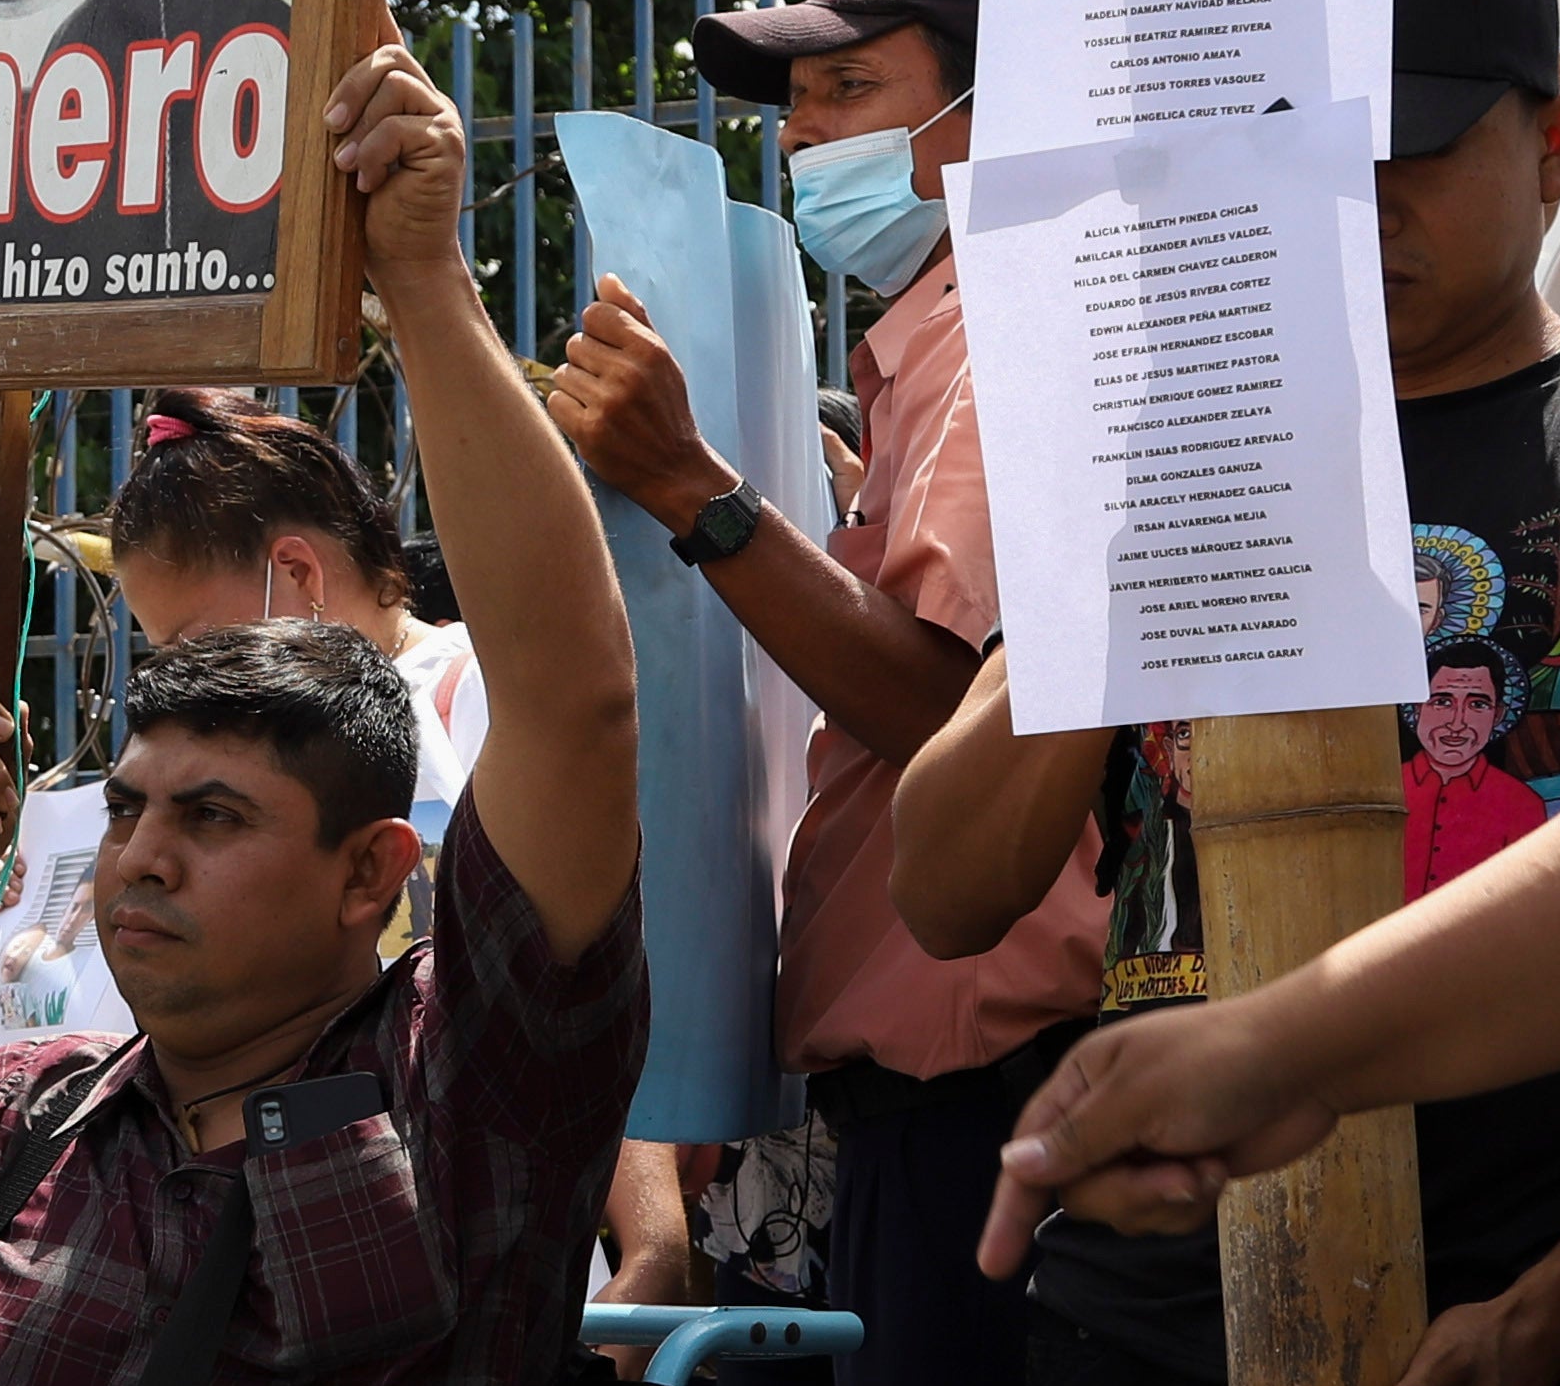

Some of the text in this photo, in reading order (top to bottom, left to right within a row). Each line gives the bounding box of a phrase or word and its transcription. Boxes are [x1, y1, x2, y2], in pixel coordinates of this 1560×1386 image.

[1110, 49, 1241, 69] CARLOS ANTONIO AMAYA
[1097, 104, 1255, 126] EVELIN ANGELICA CRUZ TEVEZ
[1084, 204, 1258, 239] ALICIA YAMILETH PINEDA CHICAS
[2, 242, 89, 298] hizo
[105, 240, 277, 295] santo...
[1093, 327, 1274, 361] JOSE EFRAIN HERNANDEZ ESCOBAR
[1108, 406, 1272, 434] FRANCISCO ALEXANDER ZELAYA
[1126, 462, 1262, 486] DILMA GONZALES GANUZA
[1134, 510, 1267, 533] IRSAN ALVARENGA MEJIA
[1139, 592, 1290, 614] JOSE ARIEL MORENO RIVERA
[1141, 648, 1304, 670] JOSE FERMELIS GARCIA GARAY
[1191, 954, 1206, 973] D
